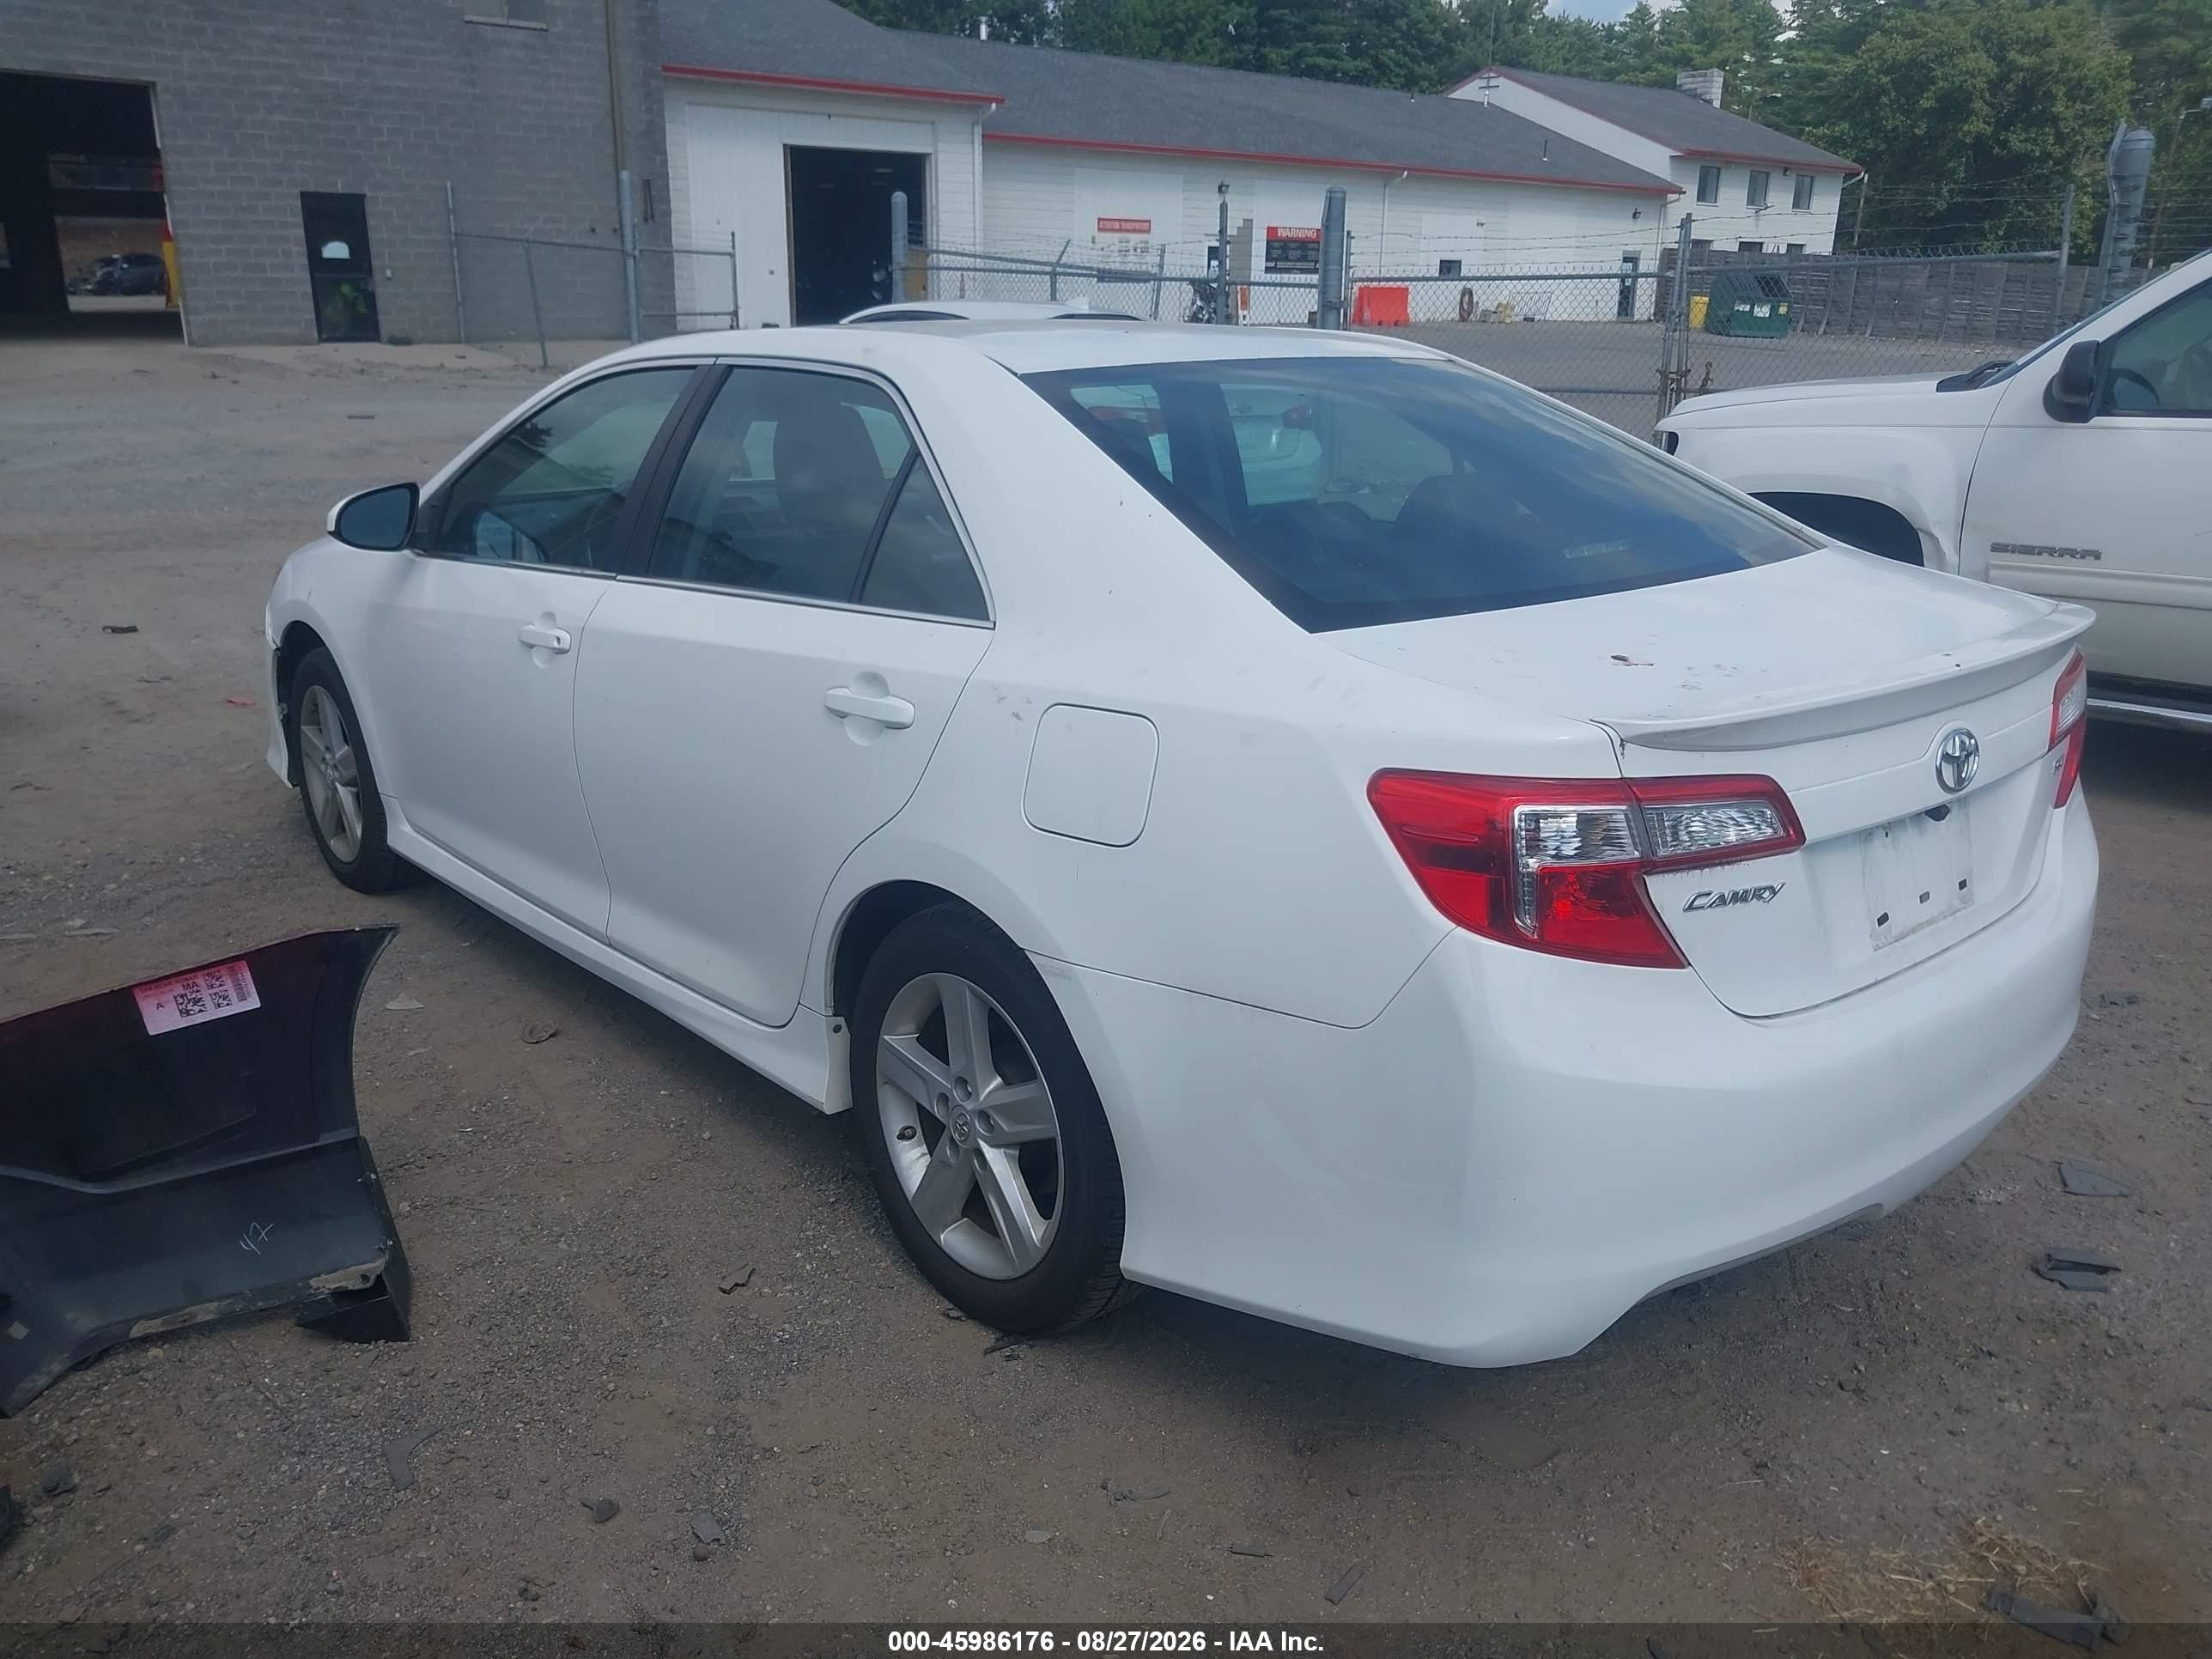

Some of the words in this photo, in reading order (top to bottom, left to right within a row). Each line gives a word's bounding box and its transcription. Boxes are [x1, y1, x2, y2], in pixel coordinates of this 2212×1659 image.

[1277, 228, 1317, 239] WARNING
[1990, 542, 2103, 561] SIERRA
[1683, 881, 1786, 912] CAMRY
[181, 981, 199, 991] MA
[156, 1002, 165, 1011] A
